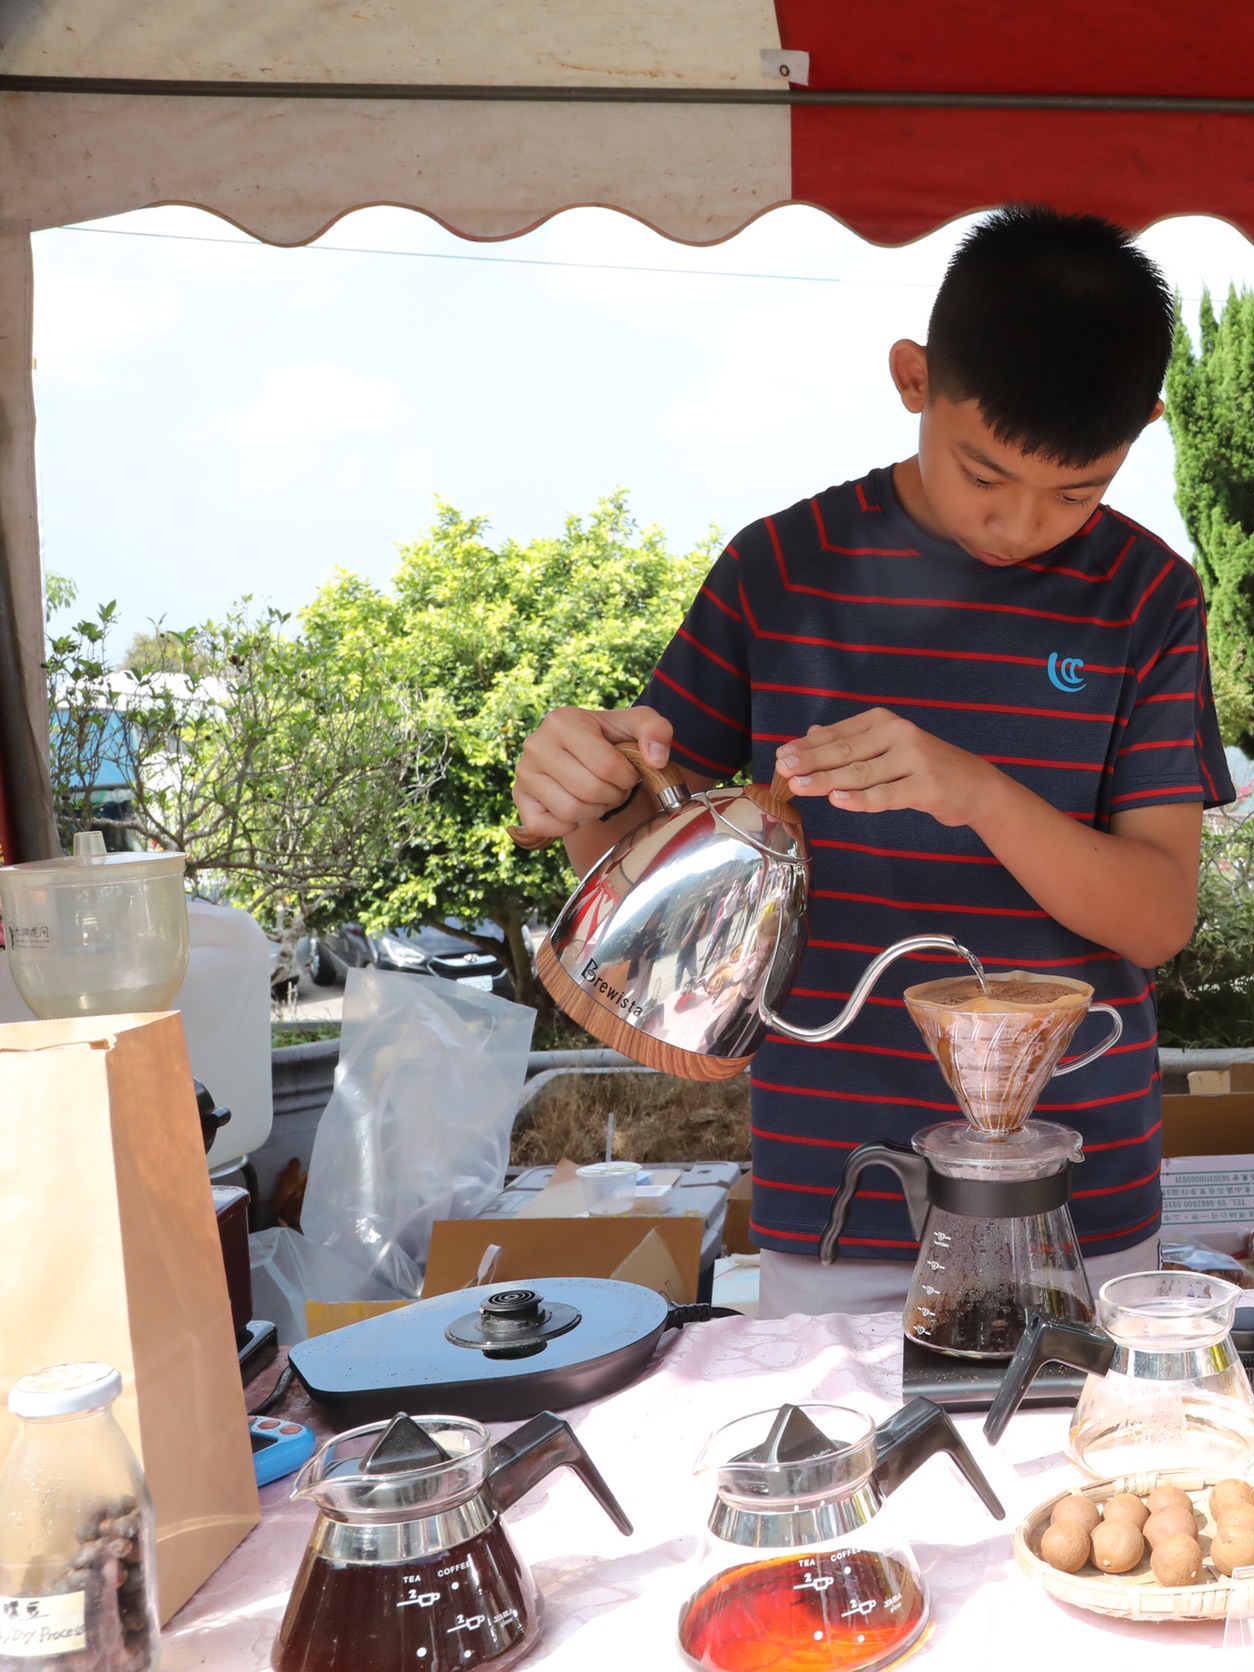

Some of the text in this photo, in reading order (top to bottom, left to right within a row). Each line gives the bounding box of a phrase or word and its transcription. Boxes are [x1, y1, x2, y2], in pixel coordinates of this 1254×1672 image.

[580, 957, 644, 1018] Brewista
[402, 1560, 472, 1584] TEA COFFEE
[798, 1559, 816, 1568] TEA
